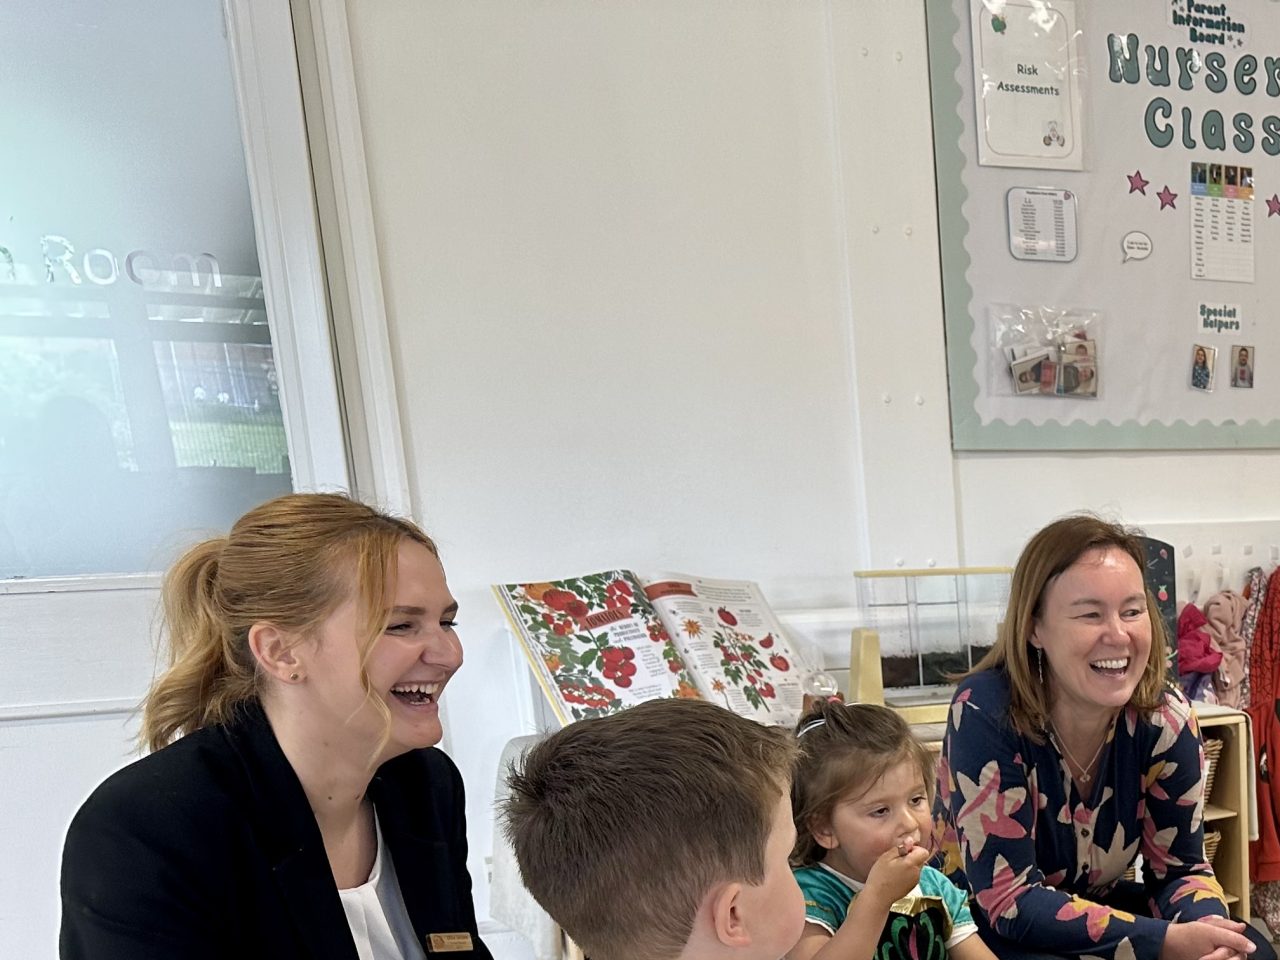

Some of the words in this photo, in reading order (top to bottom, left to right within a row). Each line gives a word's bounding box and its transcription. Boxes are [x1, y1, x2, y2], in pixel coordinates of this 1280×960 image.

[1187, 0, 1226, 16] Parent
[1172, 10, 1245, 33] Information
[1190, 27, 1225, 45] Board
[1017, 63, 1039, 76] Risk
[996, 81, 1060, 96] Assessments
[40, 234, 223, 288] Room
[1200, 304, 1236, 320] Special
[1203, 317, 1240, 333] helpers
